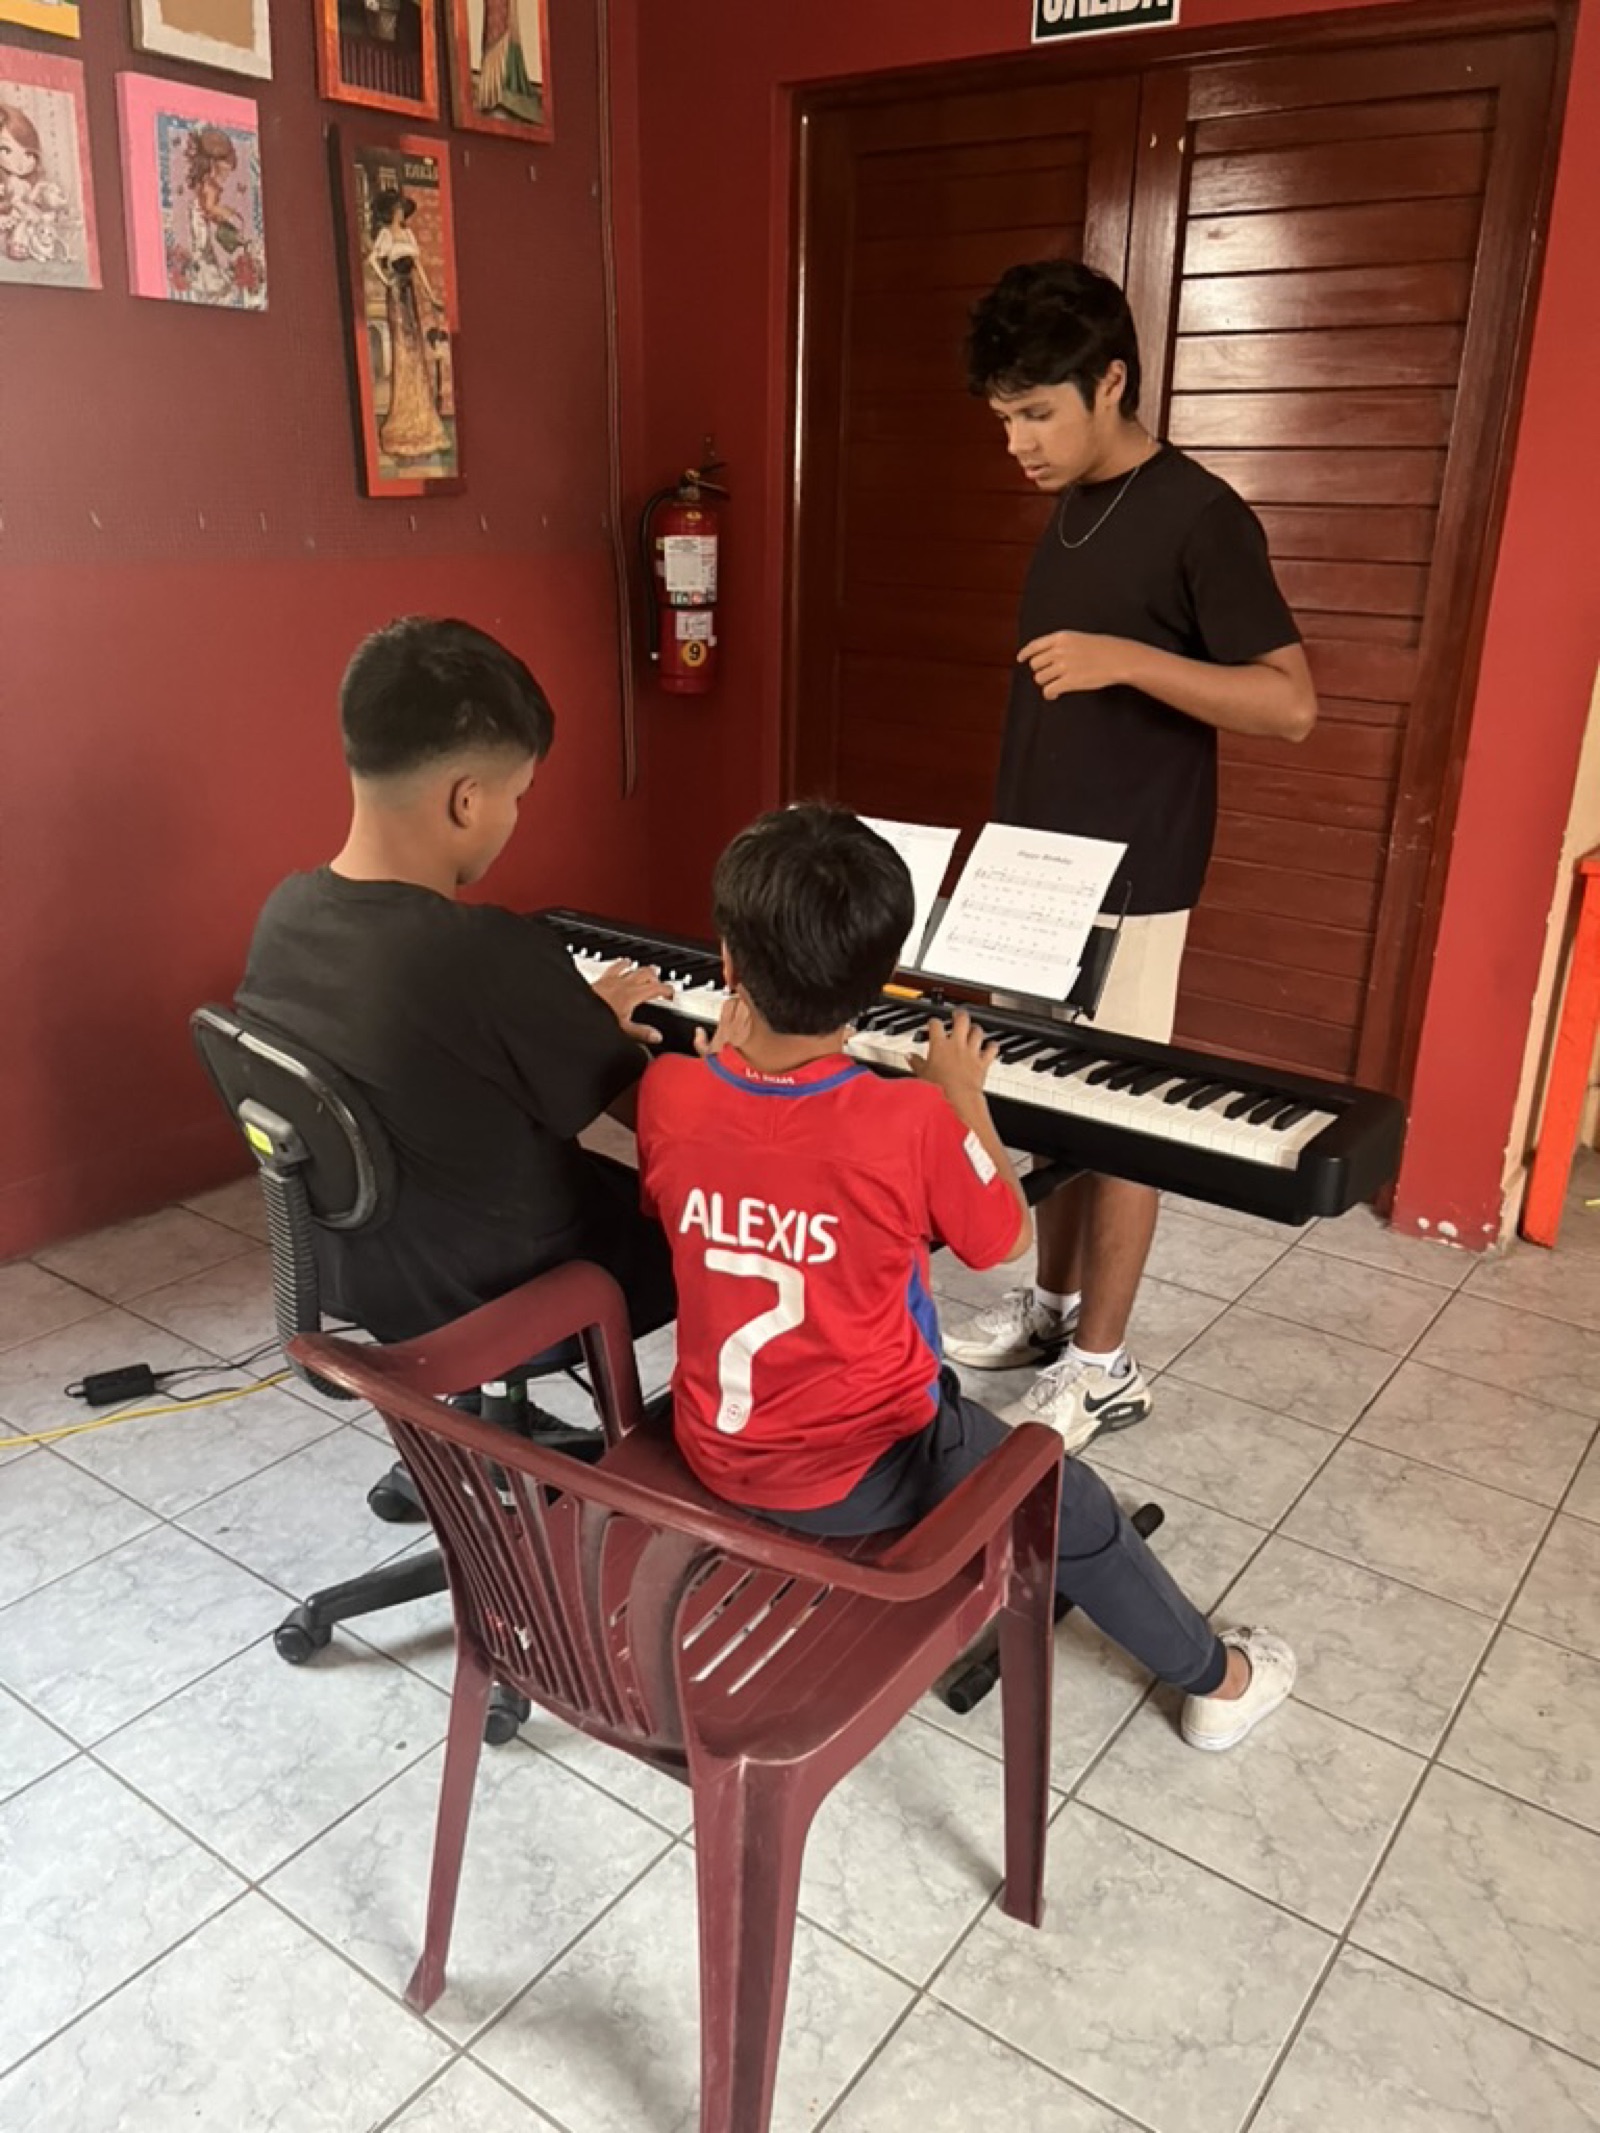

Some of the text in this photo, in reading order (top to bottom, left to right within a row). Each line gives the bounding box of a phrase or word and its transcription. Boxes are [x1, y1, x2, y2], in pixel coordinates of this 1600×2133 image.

[688, 643, 701, 660] 9
[679, 1187, 839, 1264] ALEXIS
[705, 1248, 805, 1434] 7
